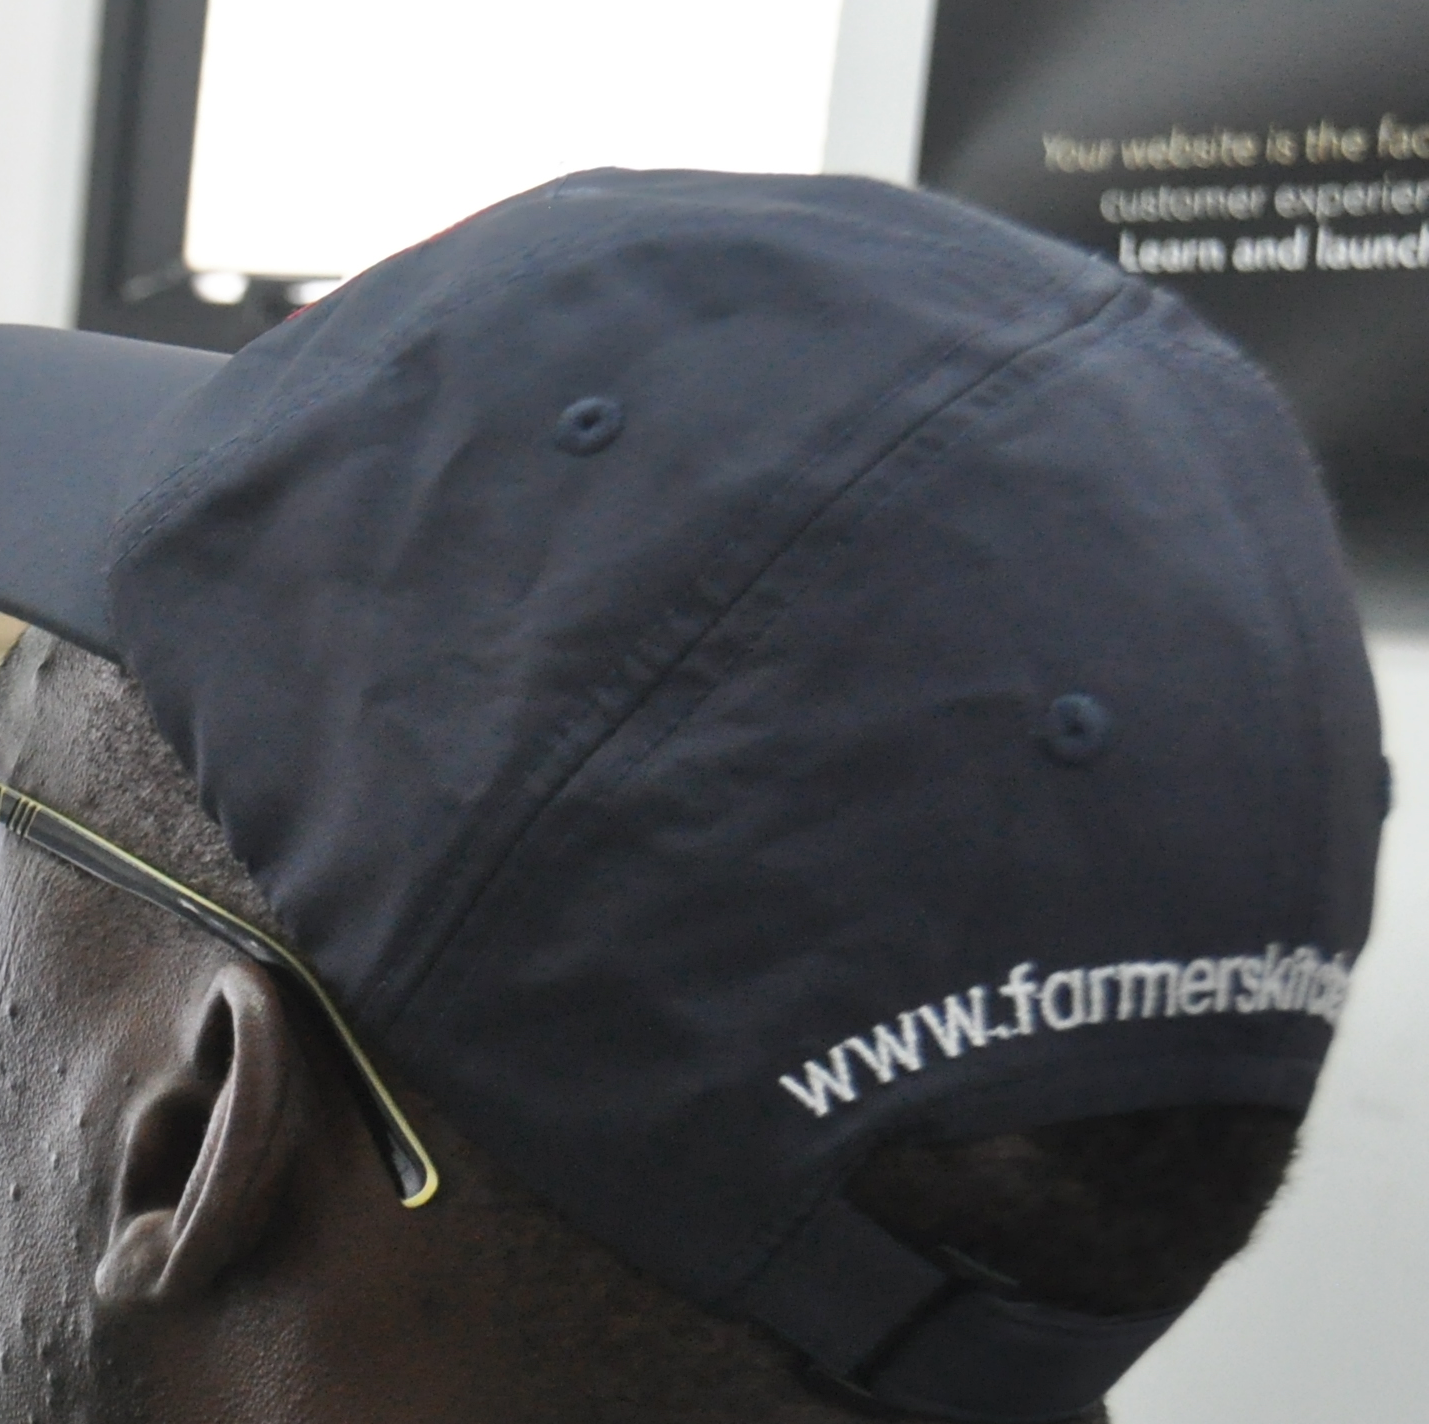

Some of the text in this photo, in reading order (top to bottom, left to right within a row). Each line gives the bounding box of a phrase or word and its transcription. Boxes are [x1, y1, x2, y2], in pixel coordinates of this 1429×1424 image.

[1042, 131, 1115, 173] Your
[1121, 124, 1261, 171] website
[1266, 122, 1298, 167] is
[1305, 118, 1370, 163] the
[1100, 184, 1266, 223] customer
[1119, 228, 1225, 273] Learn
[1232, 225, 1310, 271] and
